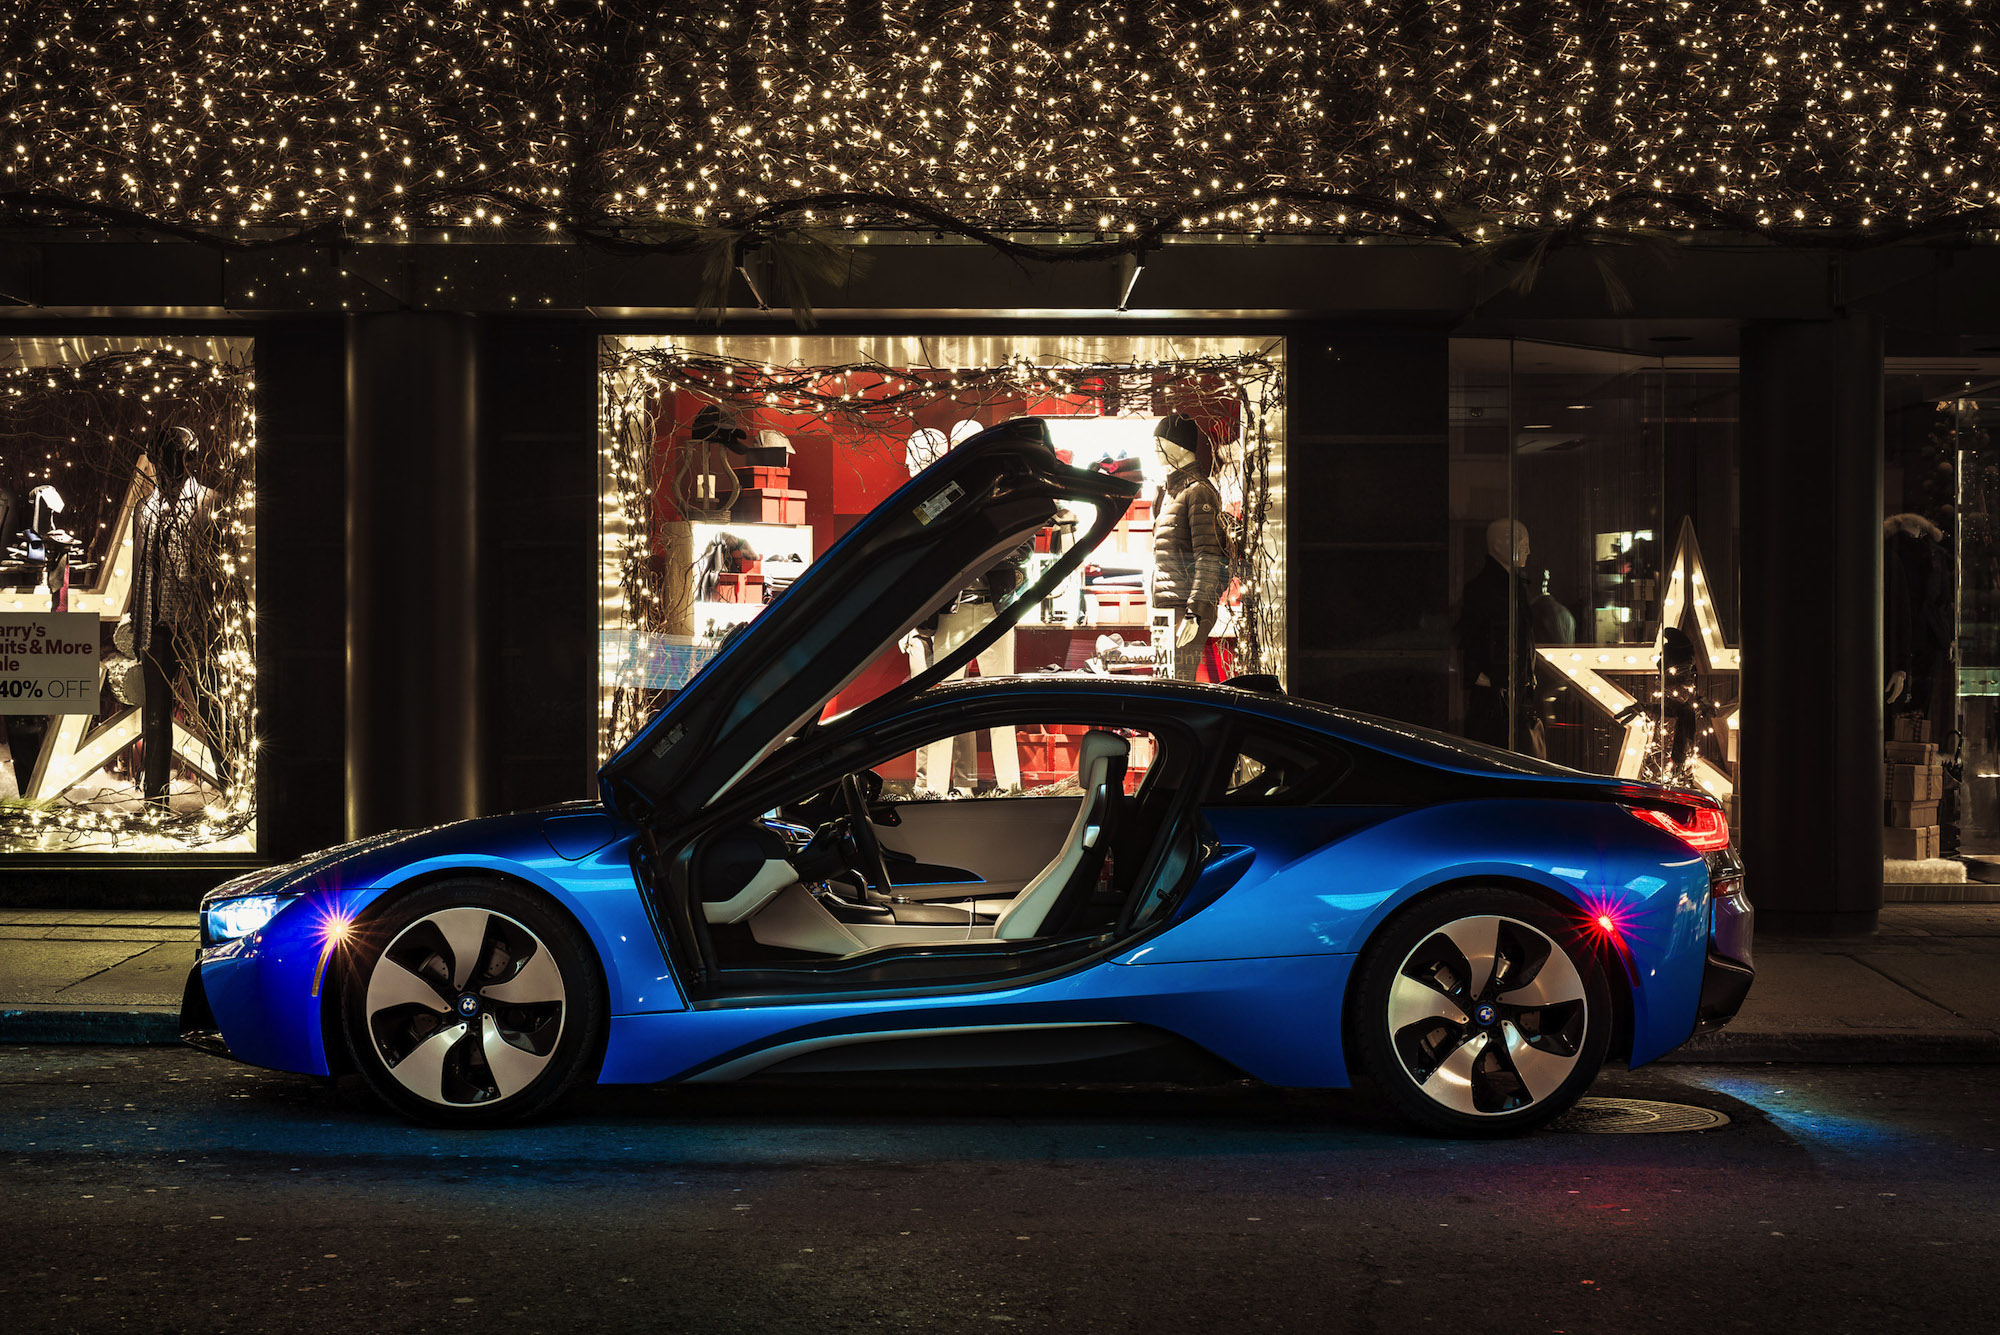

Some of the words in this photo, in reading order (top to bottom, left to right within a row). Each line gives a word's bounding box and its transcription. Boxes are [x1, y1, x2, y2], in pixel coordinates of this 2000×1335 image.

[29, 639, 43, 655] &
[45, 639, 92, 655] More
[0, 655, 20, 671] le
[0, 679, 43, 698] 40%
[47, 679, 92, 698] OFF
